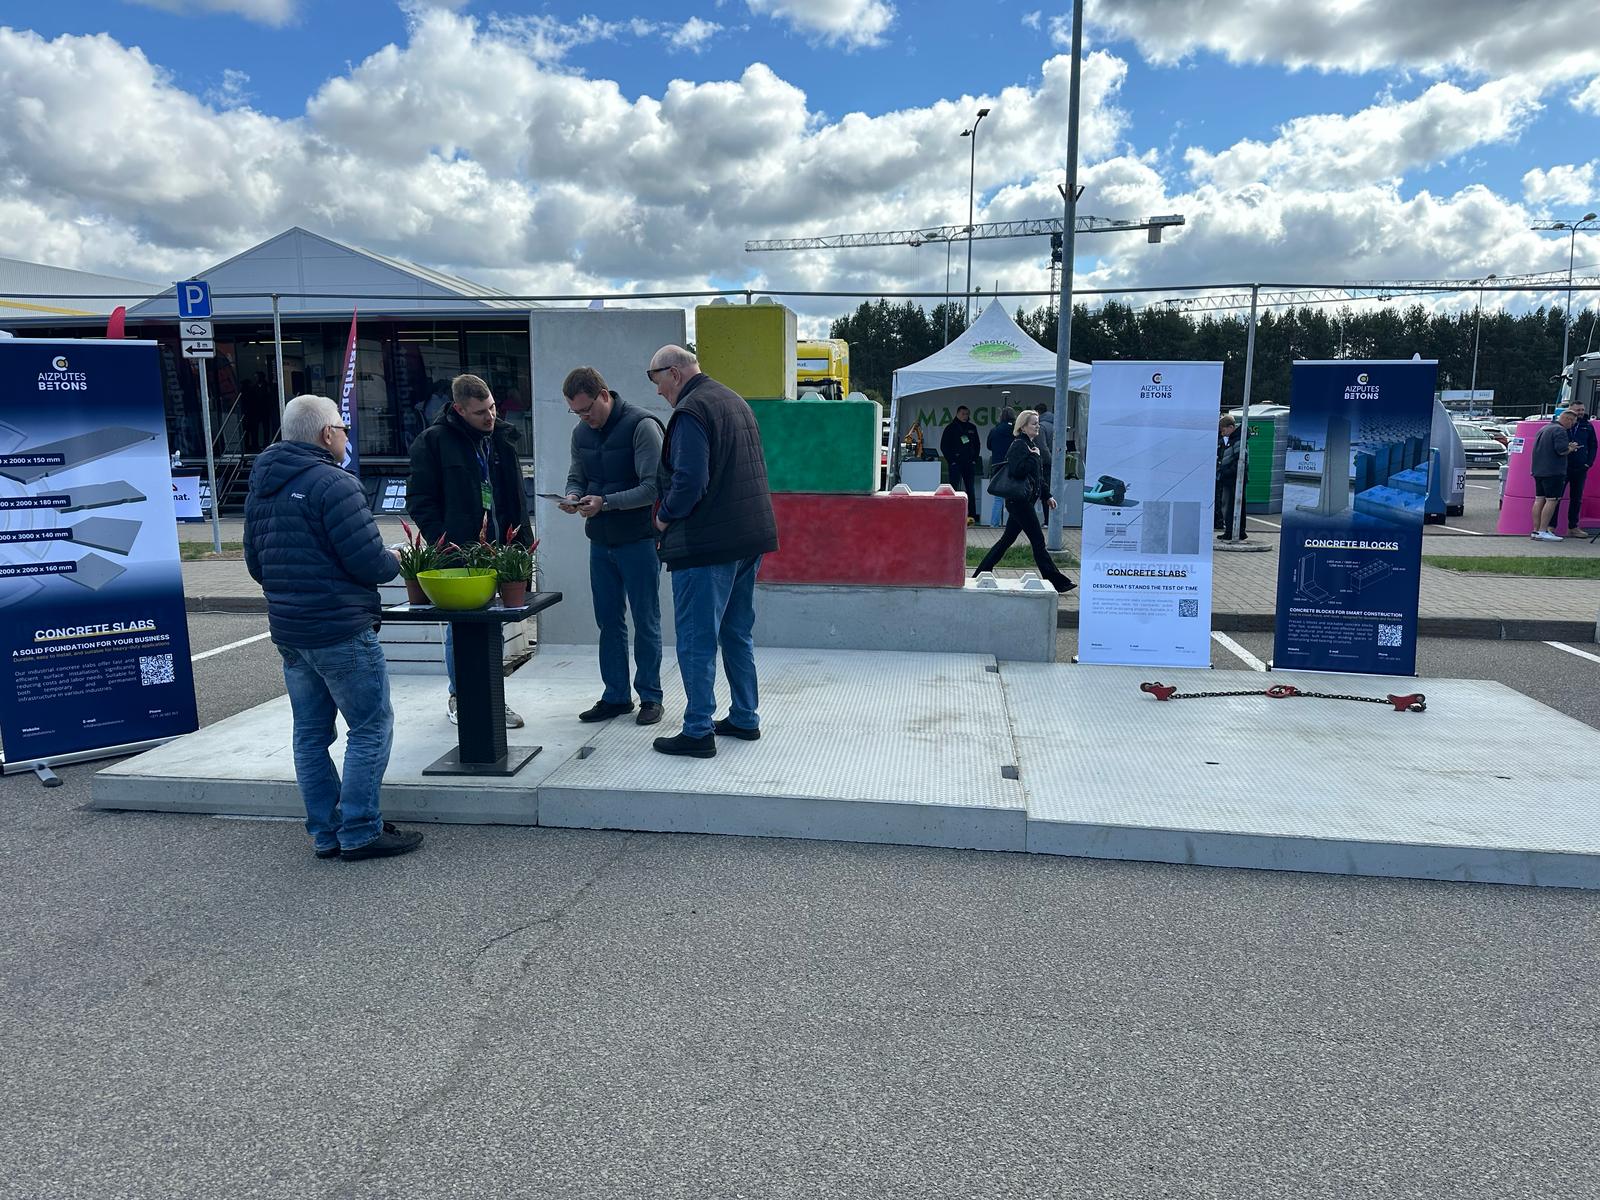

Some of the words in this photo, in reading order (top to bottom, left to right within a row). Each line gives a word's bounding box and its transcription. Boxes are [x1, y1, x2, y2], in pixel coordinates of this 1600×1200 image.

[185, 285, 203, 314] P
[38, 372, 87, 381] AIZPUTES
[38, 382, 88, 390] BETONS
[1457, 475, 1465, 483] TO
[1304, 539, 1358, 548] CONCRETE
[1360, 541, 1399, 550] BLOCKS
[1106, 568, 1156, 576] CONCRETE
[1158, 570, 1187, 578] SLABS
[34, 624, 110, 640] CONCRETE
[112, 620, 155, 632] SLABS
[20, 648, 44, 656] SOLID
[44, 642, 95, 654] FOUNDATION
[134, 634, 170, 644] BUSINESS
